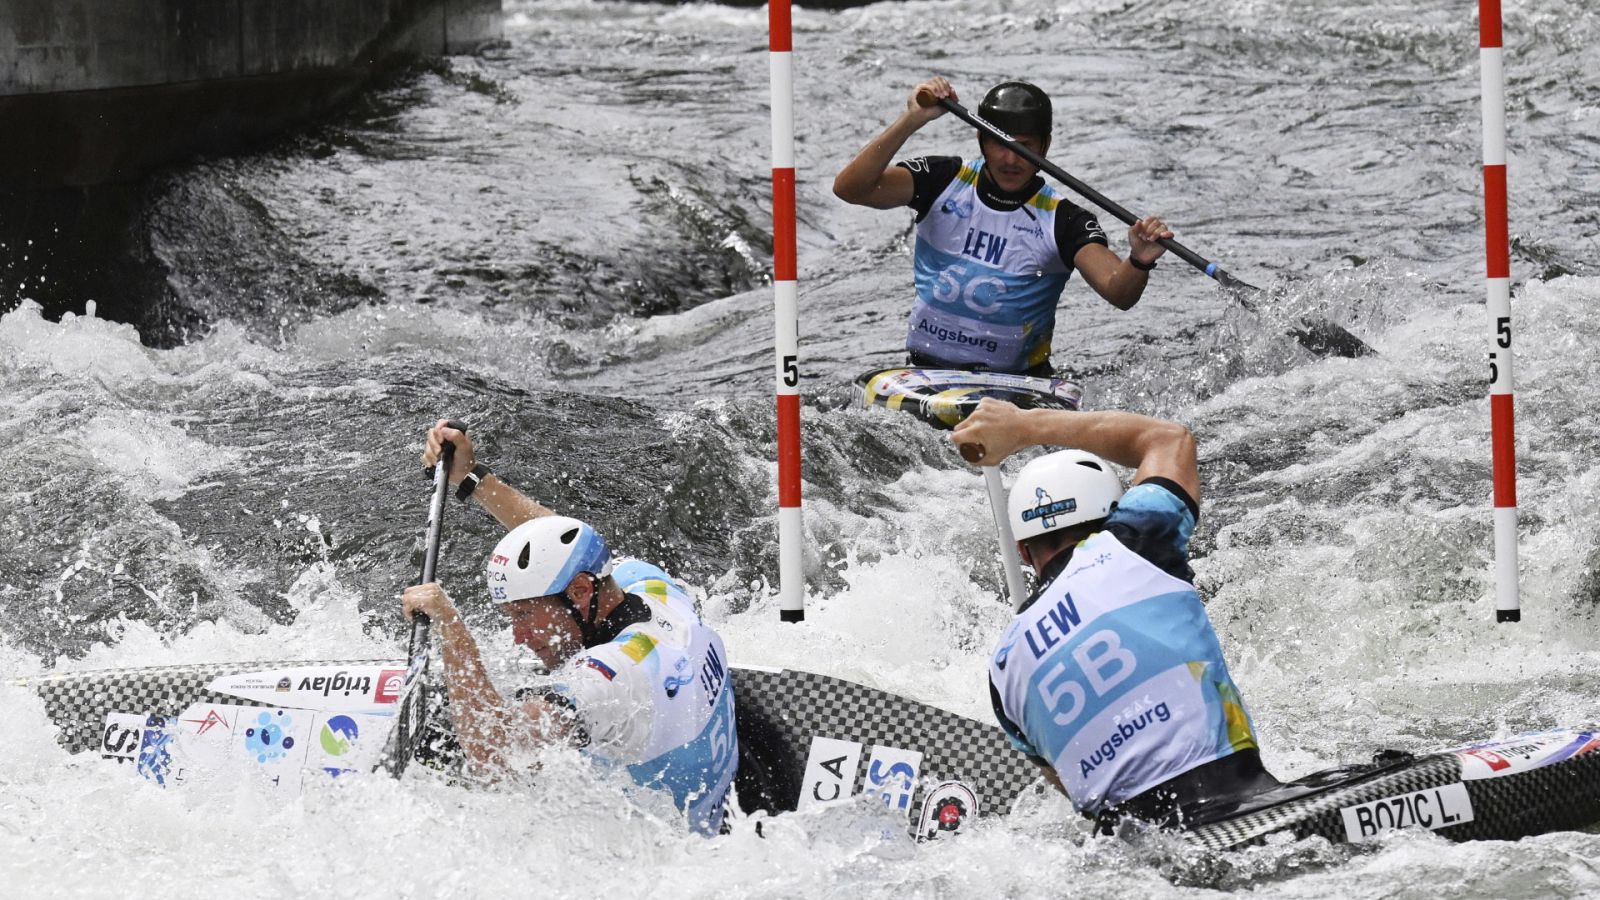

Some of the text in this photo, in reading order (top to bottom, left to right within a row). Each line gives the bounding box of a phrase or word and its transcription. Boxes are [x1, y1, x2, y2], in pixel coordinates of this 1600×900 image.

[962, 227, 1008, 265] LEW
[932, 264, 1008, 314] 5C
[918, 318, 999, 353] Augsburg
[1496, 316, 1511, 349] 5
[783, 355, 798, 388] 5
[1024, 592, 1082, 661] LEW
[297, 671, 371, 697] triglav
[700, 642, 724, 707] LEW
[1036, 629, 1137, 727] 5B
[1079, 701, 1171, 779] Augsburg
[1355, 789, 1461, 838] BOZIC L.
